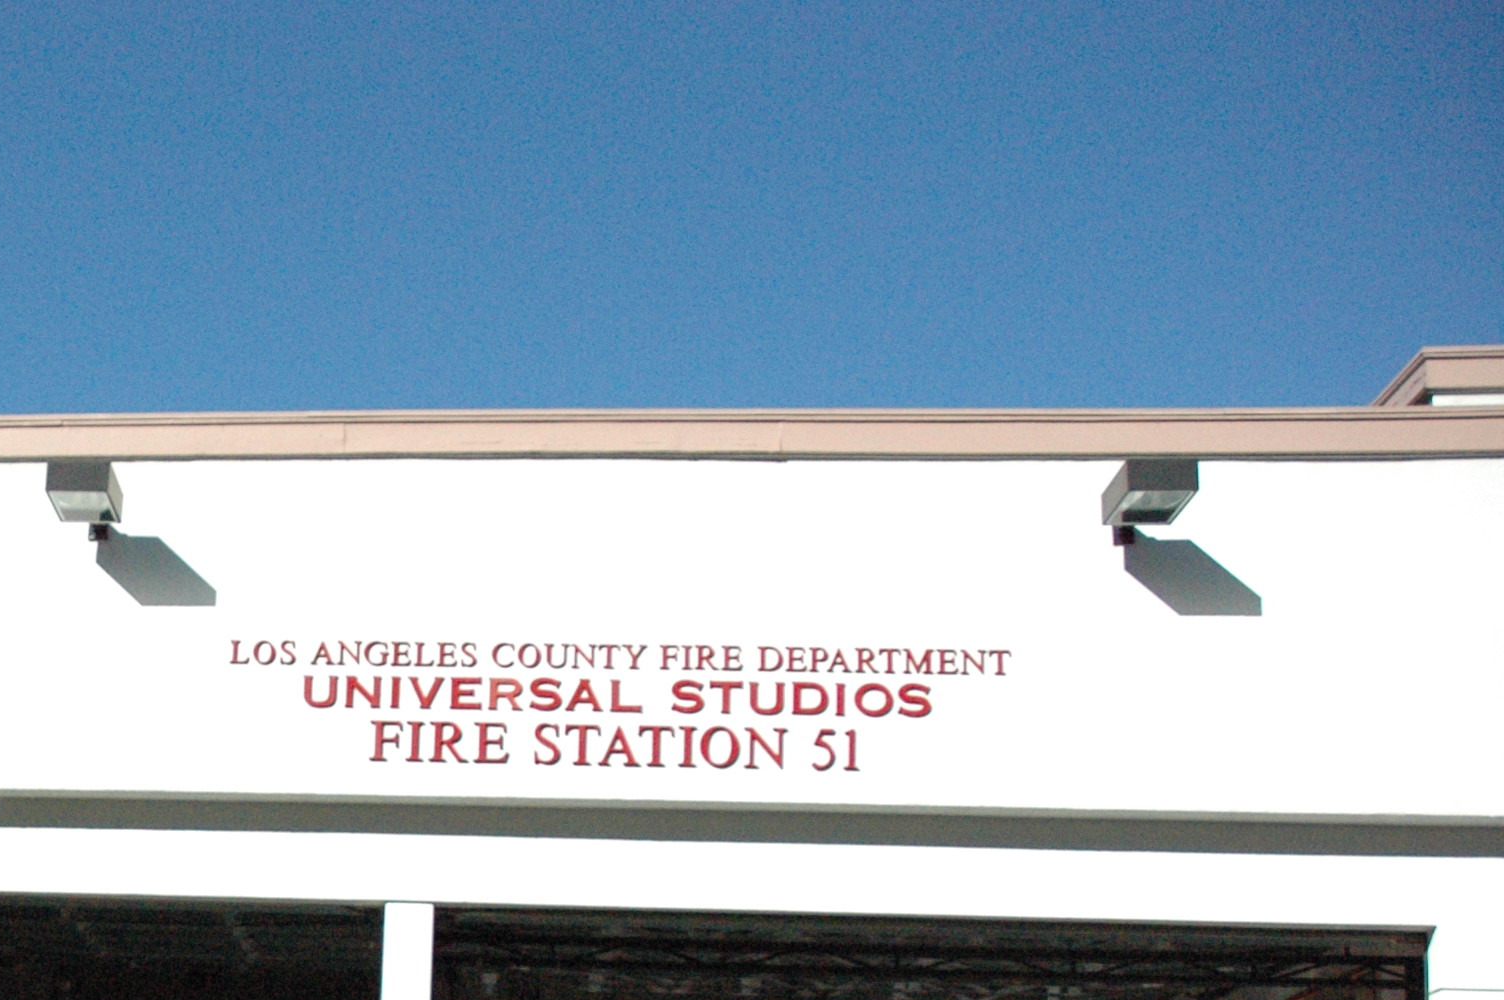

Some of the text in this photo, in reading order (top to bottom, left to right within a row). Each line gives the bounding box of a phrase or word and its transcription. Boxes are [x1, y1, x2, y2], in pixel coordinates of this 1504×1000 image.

[229, 640, 1012, 676] LOS ANGELES COUNTY FIRE DEPARTMENT
[303, 675, 933, 719] UNIVERSAL STUDIOS
[369, 720, 860, 772] FIRE STATION 51
